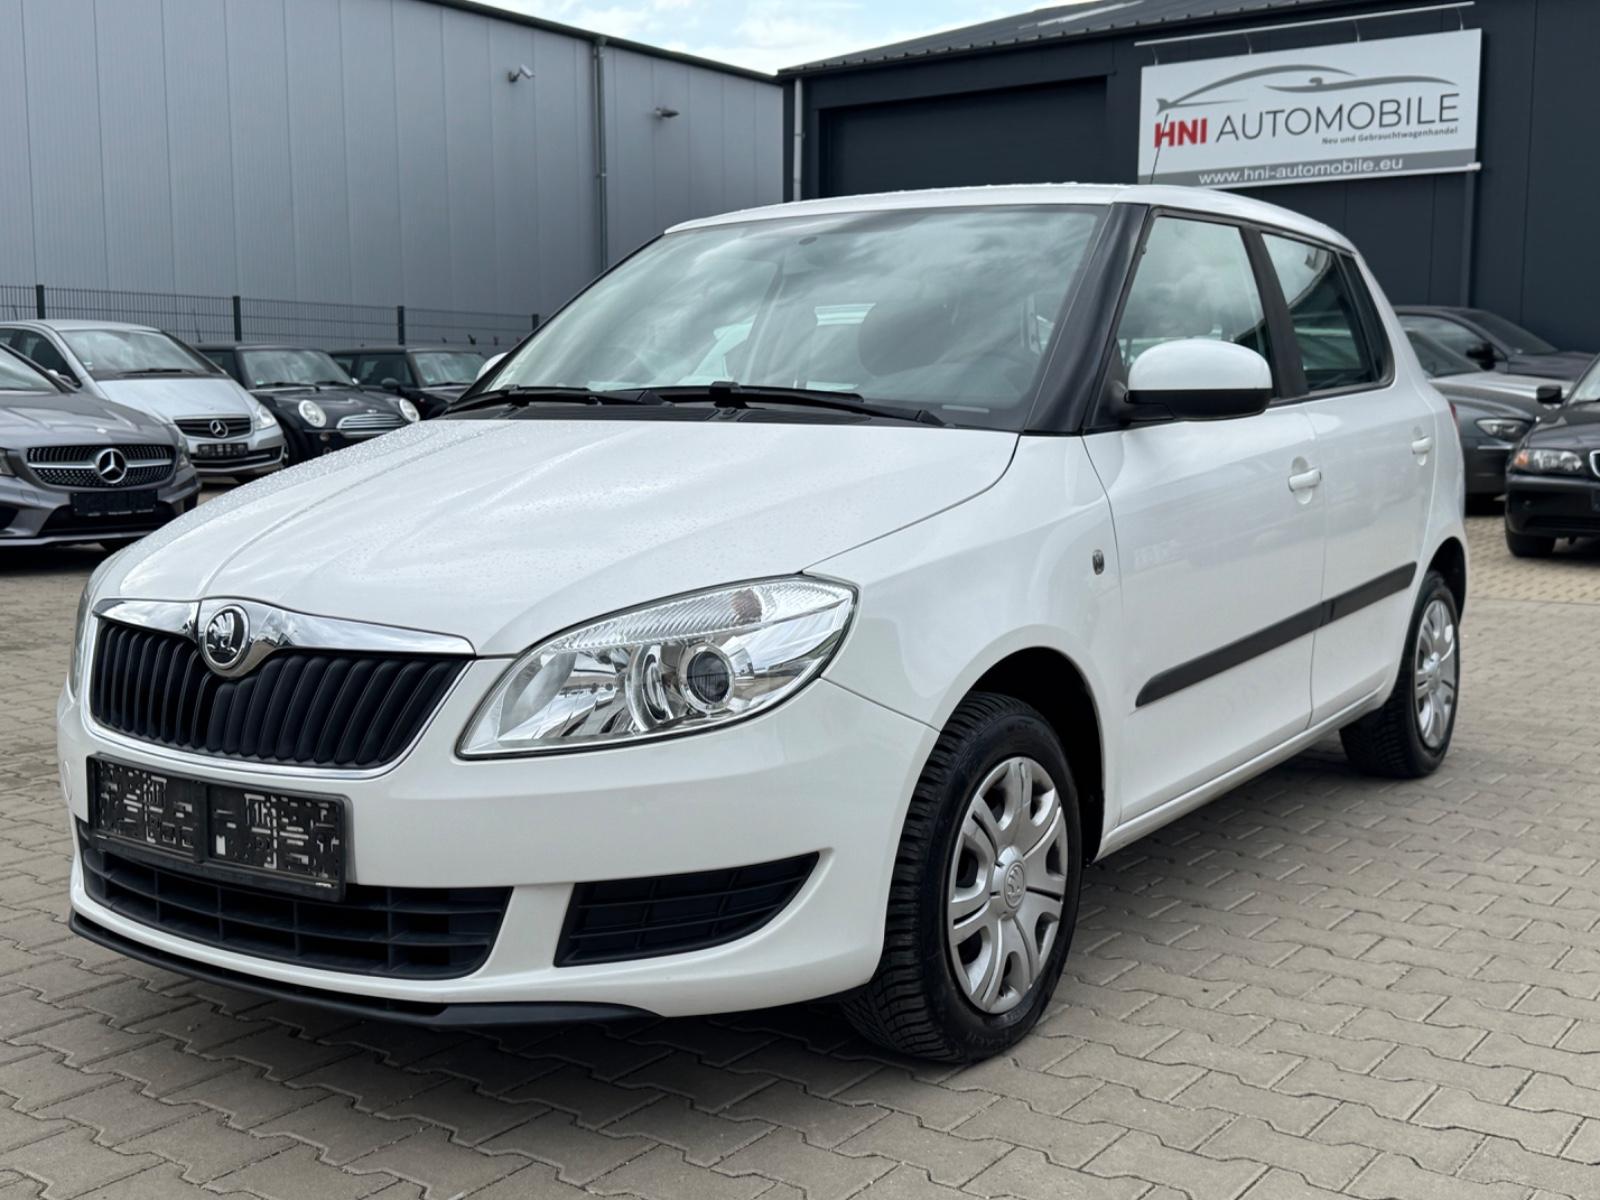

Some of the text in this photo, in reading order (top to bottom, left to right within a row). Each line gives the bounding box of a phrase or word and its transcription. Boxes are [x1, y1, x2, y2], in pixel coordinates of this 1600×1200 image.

[1154, 93, 1459, 148] HNI AUTOMOBILE
[1321, 127, 1458, 145] Neu und Gebrauchtwagenhandel
[1199, 158, 1403, 185] www.hni-automobile.eu
